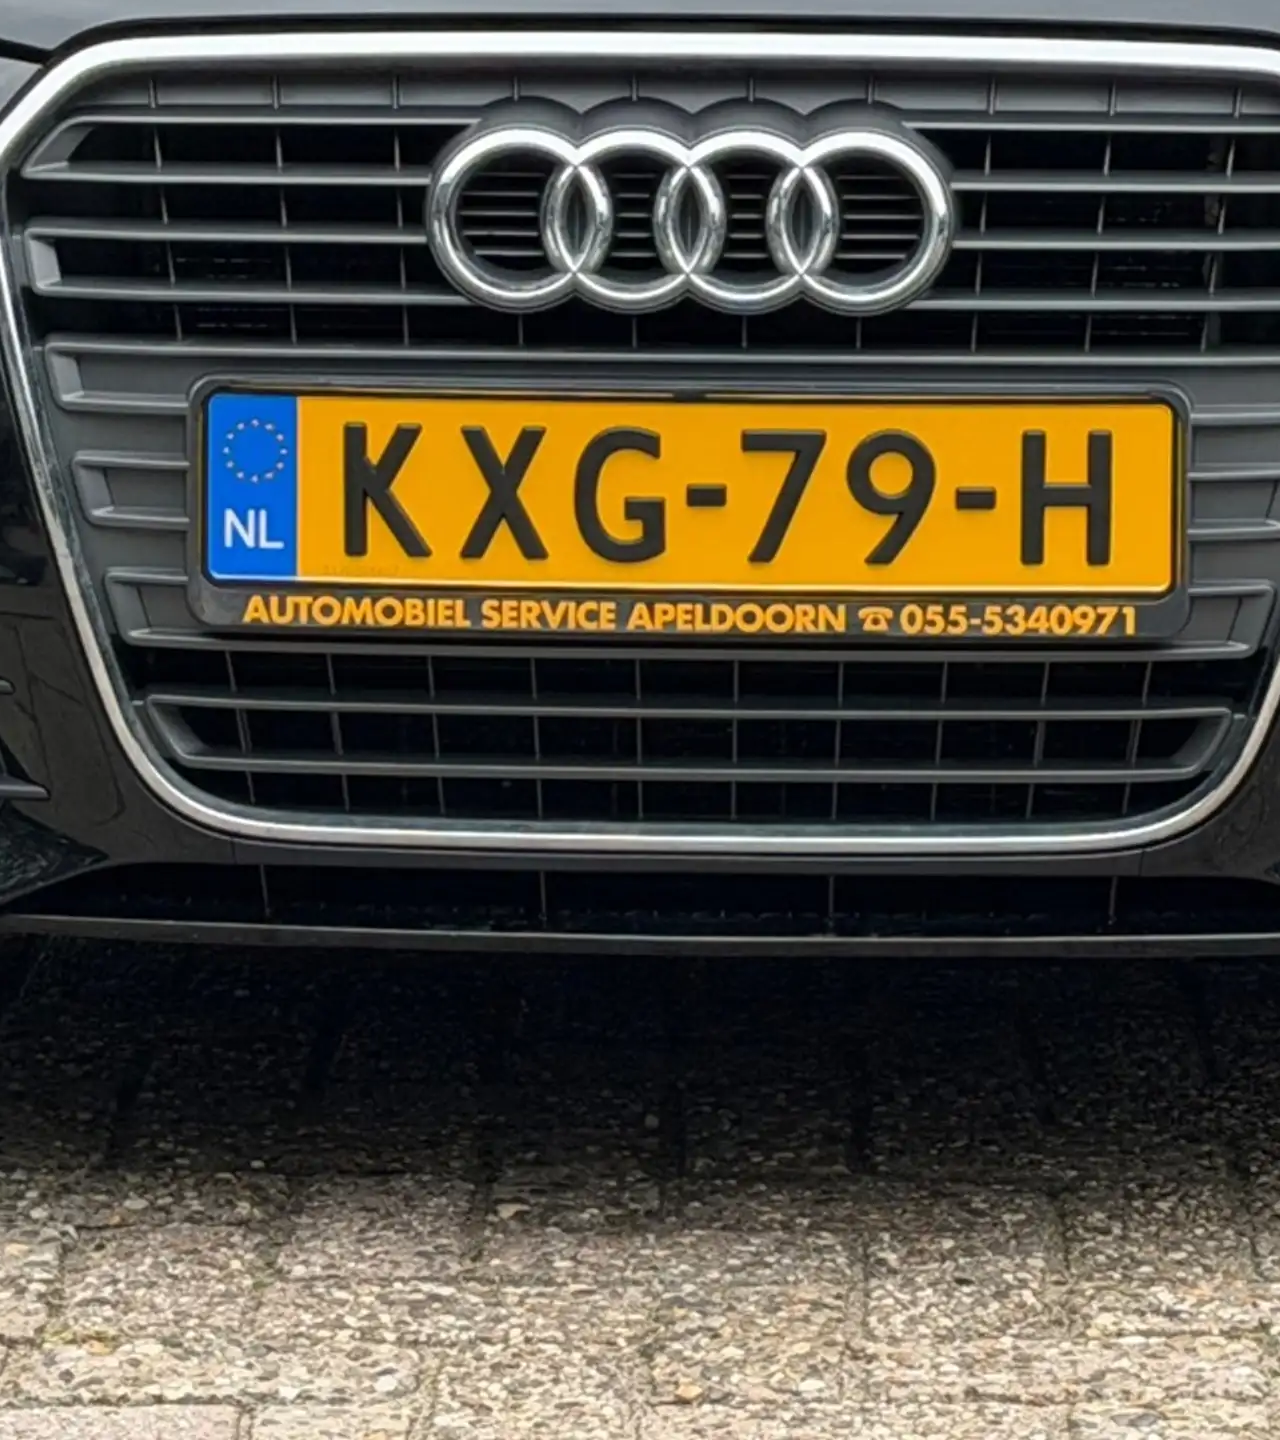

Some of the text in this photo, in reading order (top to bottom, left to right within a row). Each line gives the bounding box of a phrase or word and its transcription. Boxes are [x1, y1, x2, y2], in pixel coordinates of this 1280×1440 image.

[343, 422, 1114, 567] KXG-79-H
[224, 508, 285, 549] NL
[242, 594, 1137, 637] AUTOMOBIEL SERVICE APELDOORN 055-5340971
